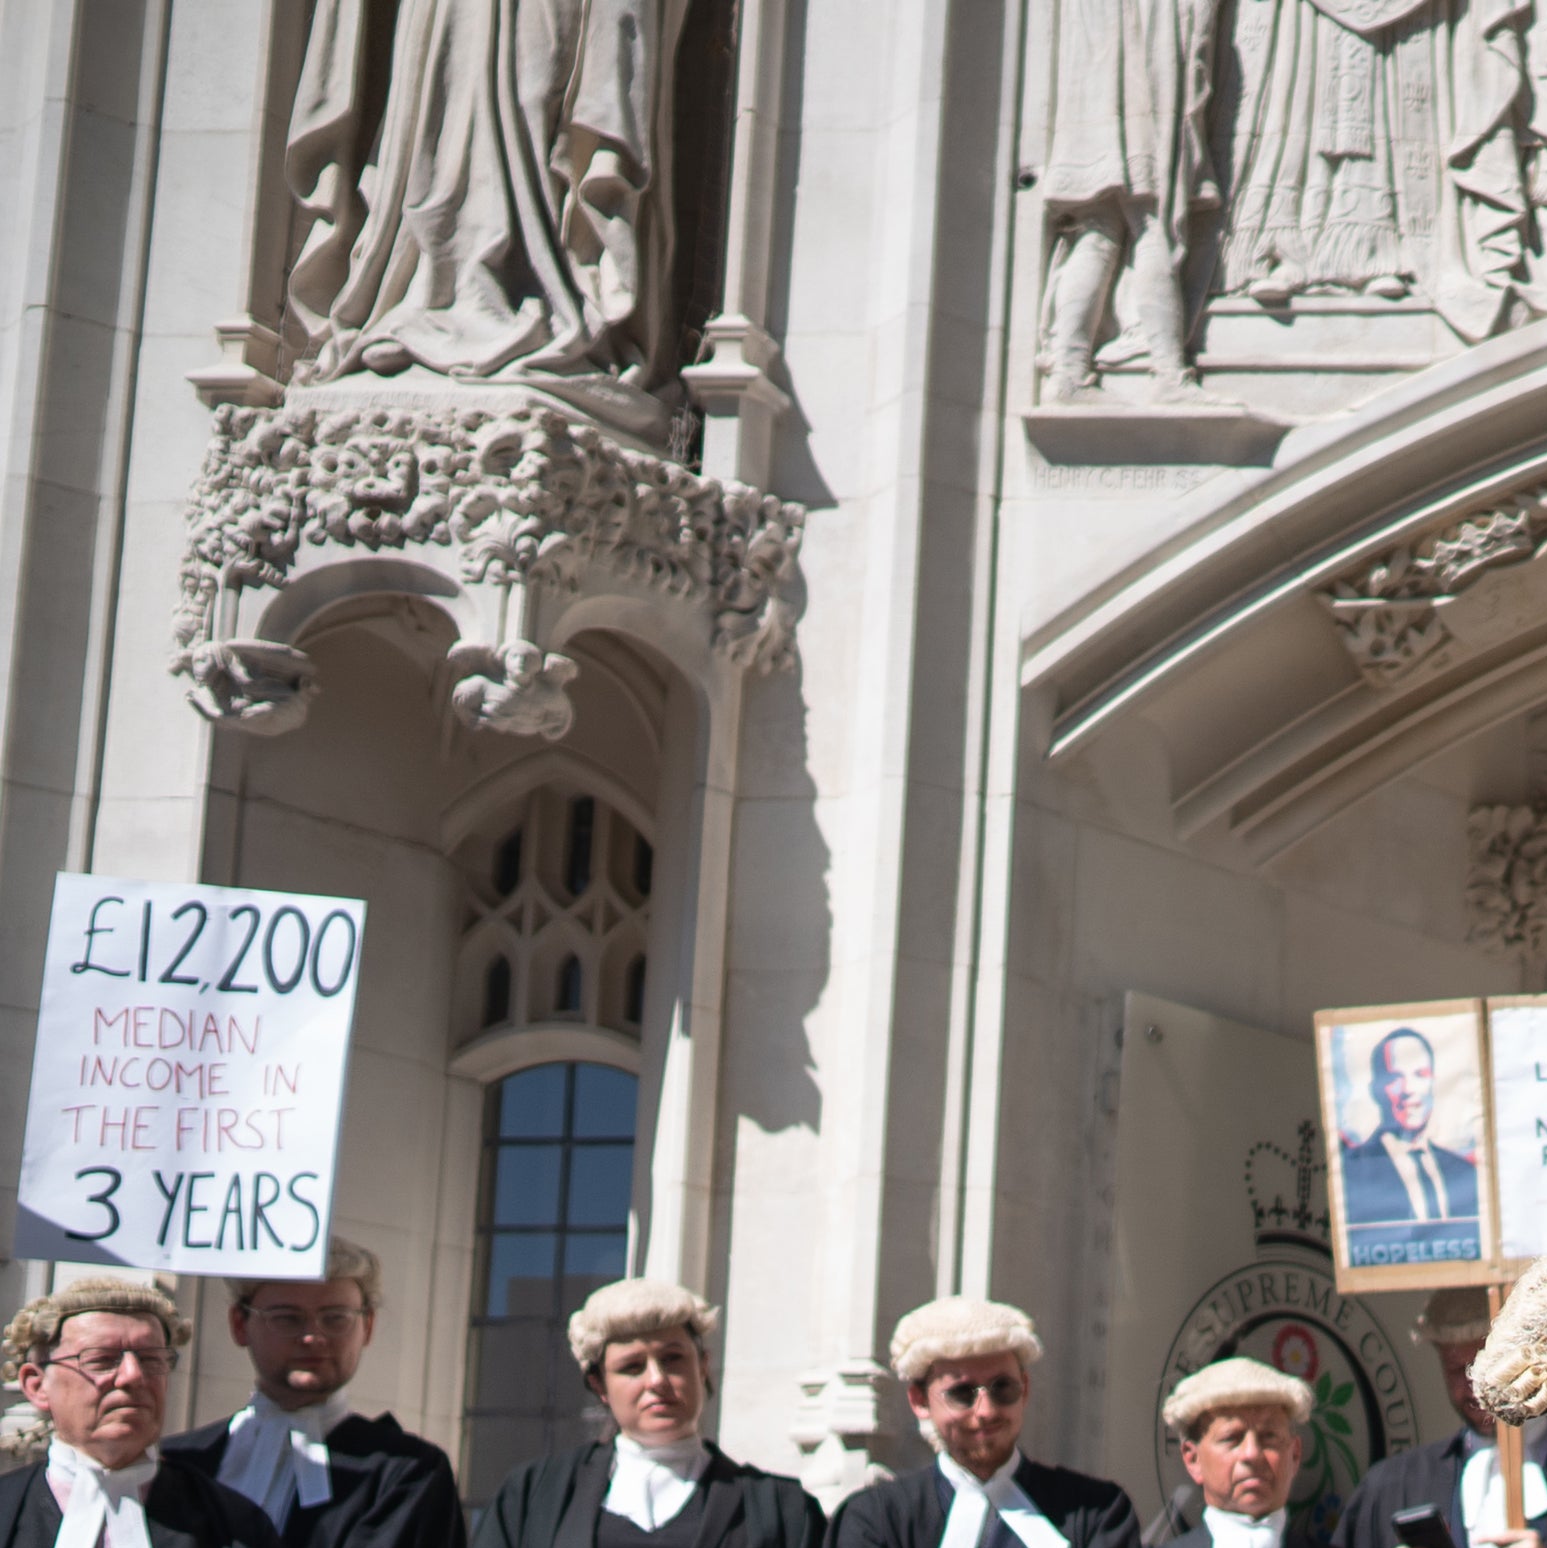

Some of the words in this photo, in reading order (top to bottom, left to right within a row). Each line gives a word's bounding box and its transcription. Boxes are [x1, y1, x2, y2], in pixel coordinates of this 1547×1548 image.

[69, 896, 357, 998] £12,200
[93, 1006, 261, 1055] MEDIAN
[79, 1055, 230, 1100] INCOME
[263, 1062, 302, 1097] IN
[62, 1103, 160, 1150] THE
[175, 1106, 297, 1152] FIRST
[65, 1165, 123, 1242] 3
[153, 1169, 321, 1253] YEARS
[1353, 1238, 1479, 1265] HOPELESS
[1194, 1271, 1354, 1344] SUPREME
